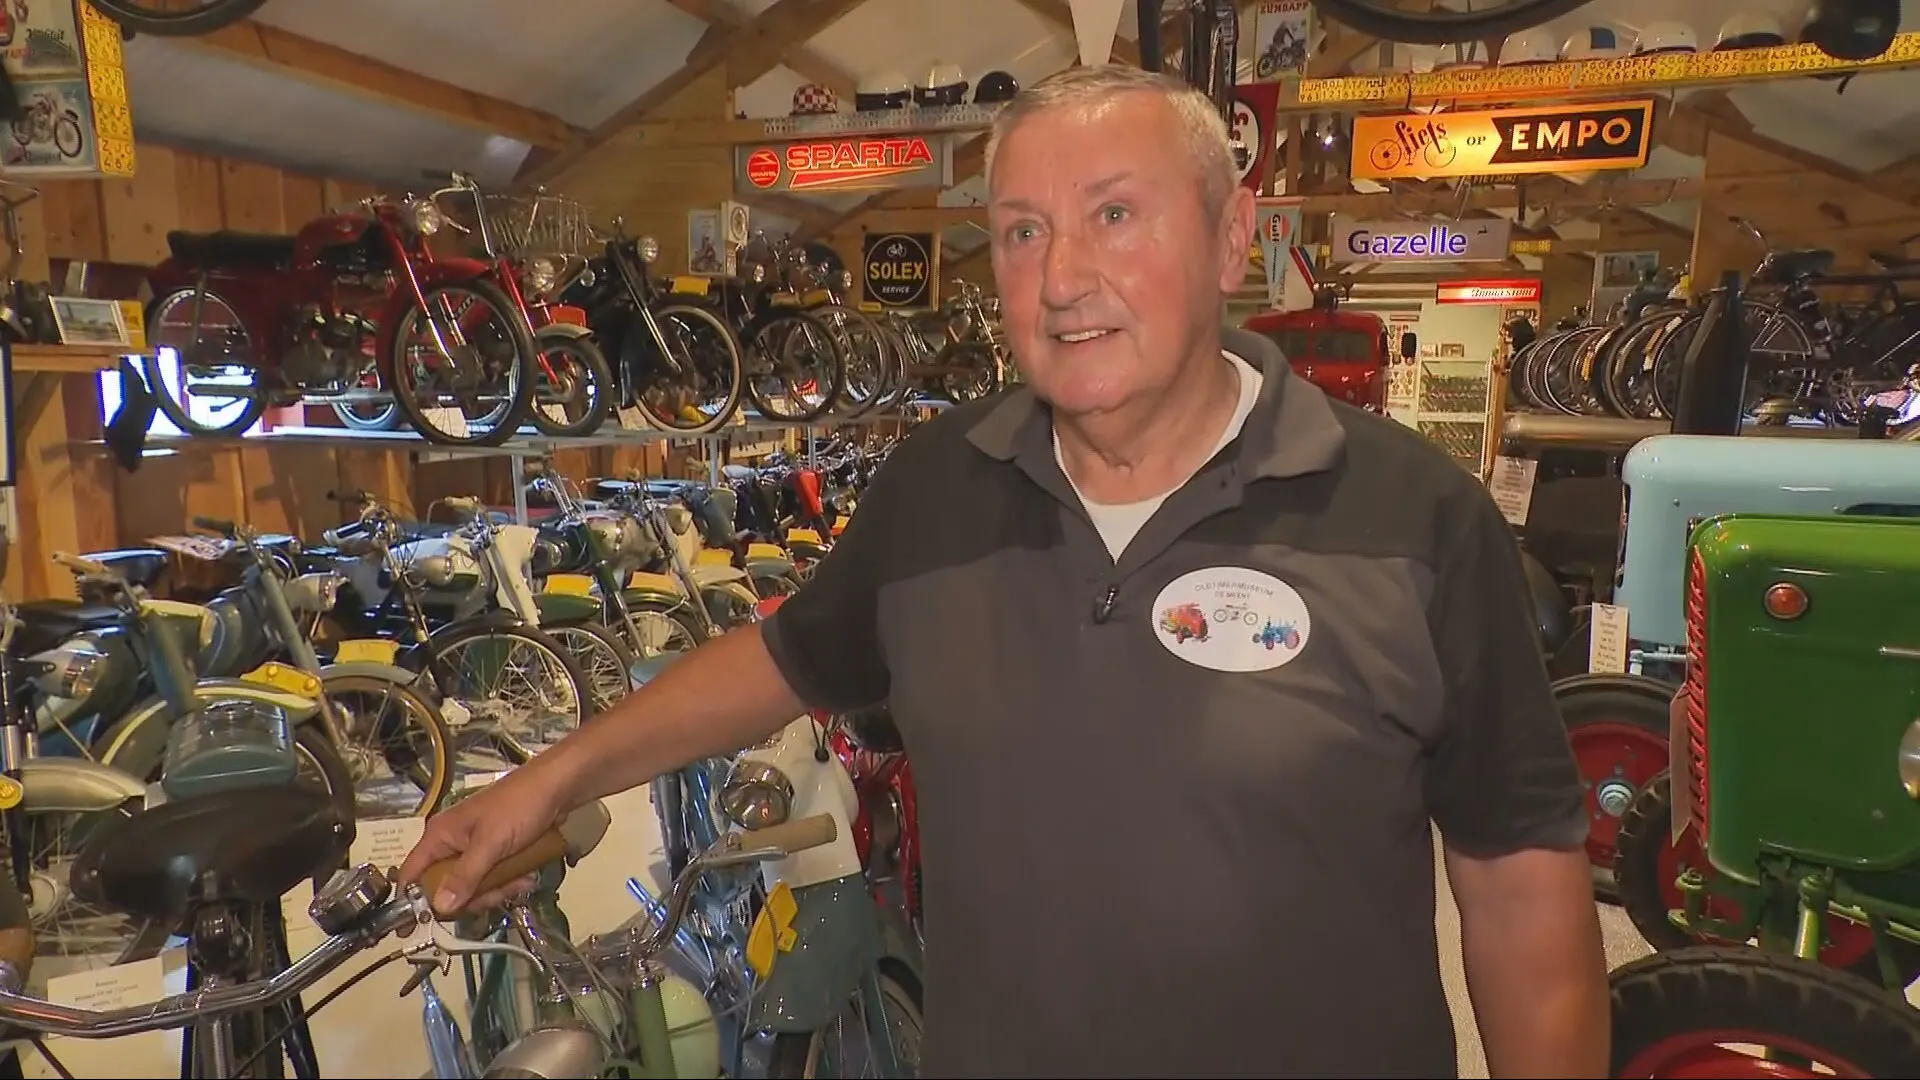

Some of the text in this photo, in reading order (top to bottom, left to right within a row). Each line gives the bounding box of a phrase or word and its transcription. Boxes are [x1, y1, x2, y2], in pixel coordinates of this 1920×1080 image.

[1511, 117, 1632, 150] EMPO
[786, 137, 934, 170] SPARTA
[1348, 226, 1468, 255] Gazelle
[870, 261, 924, 280] SOLEX
